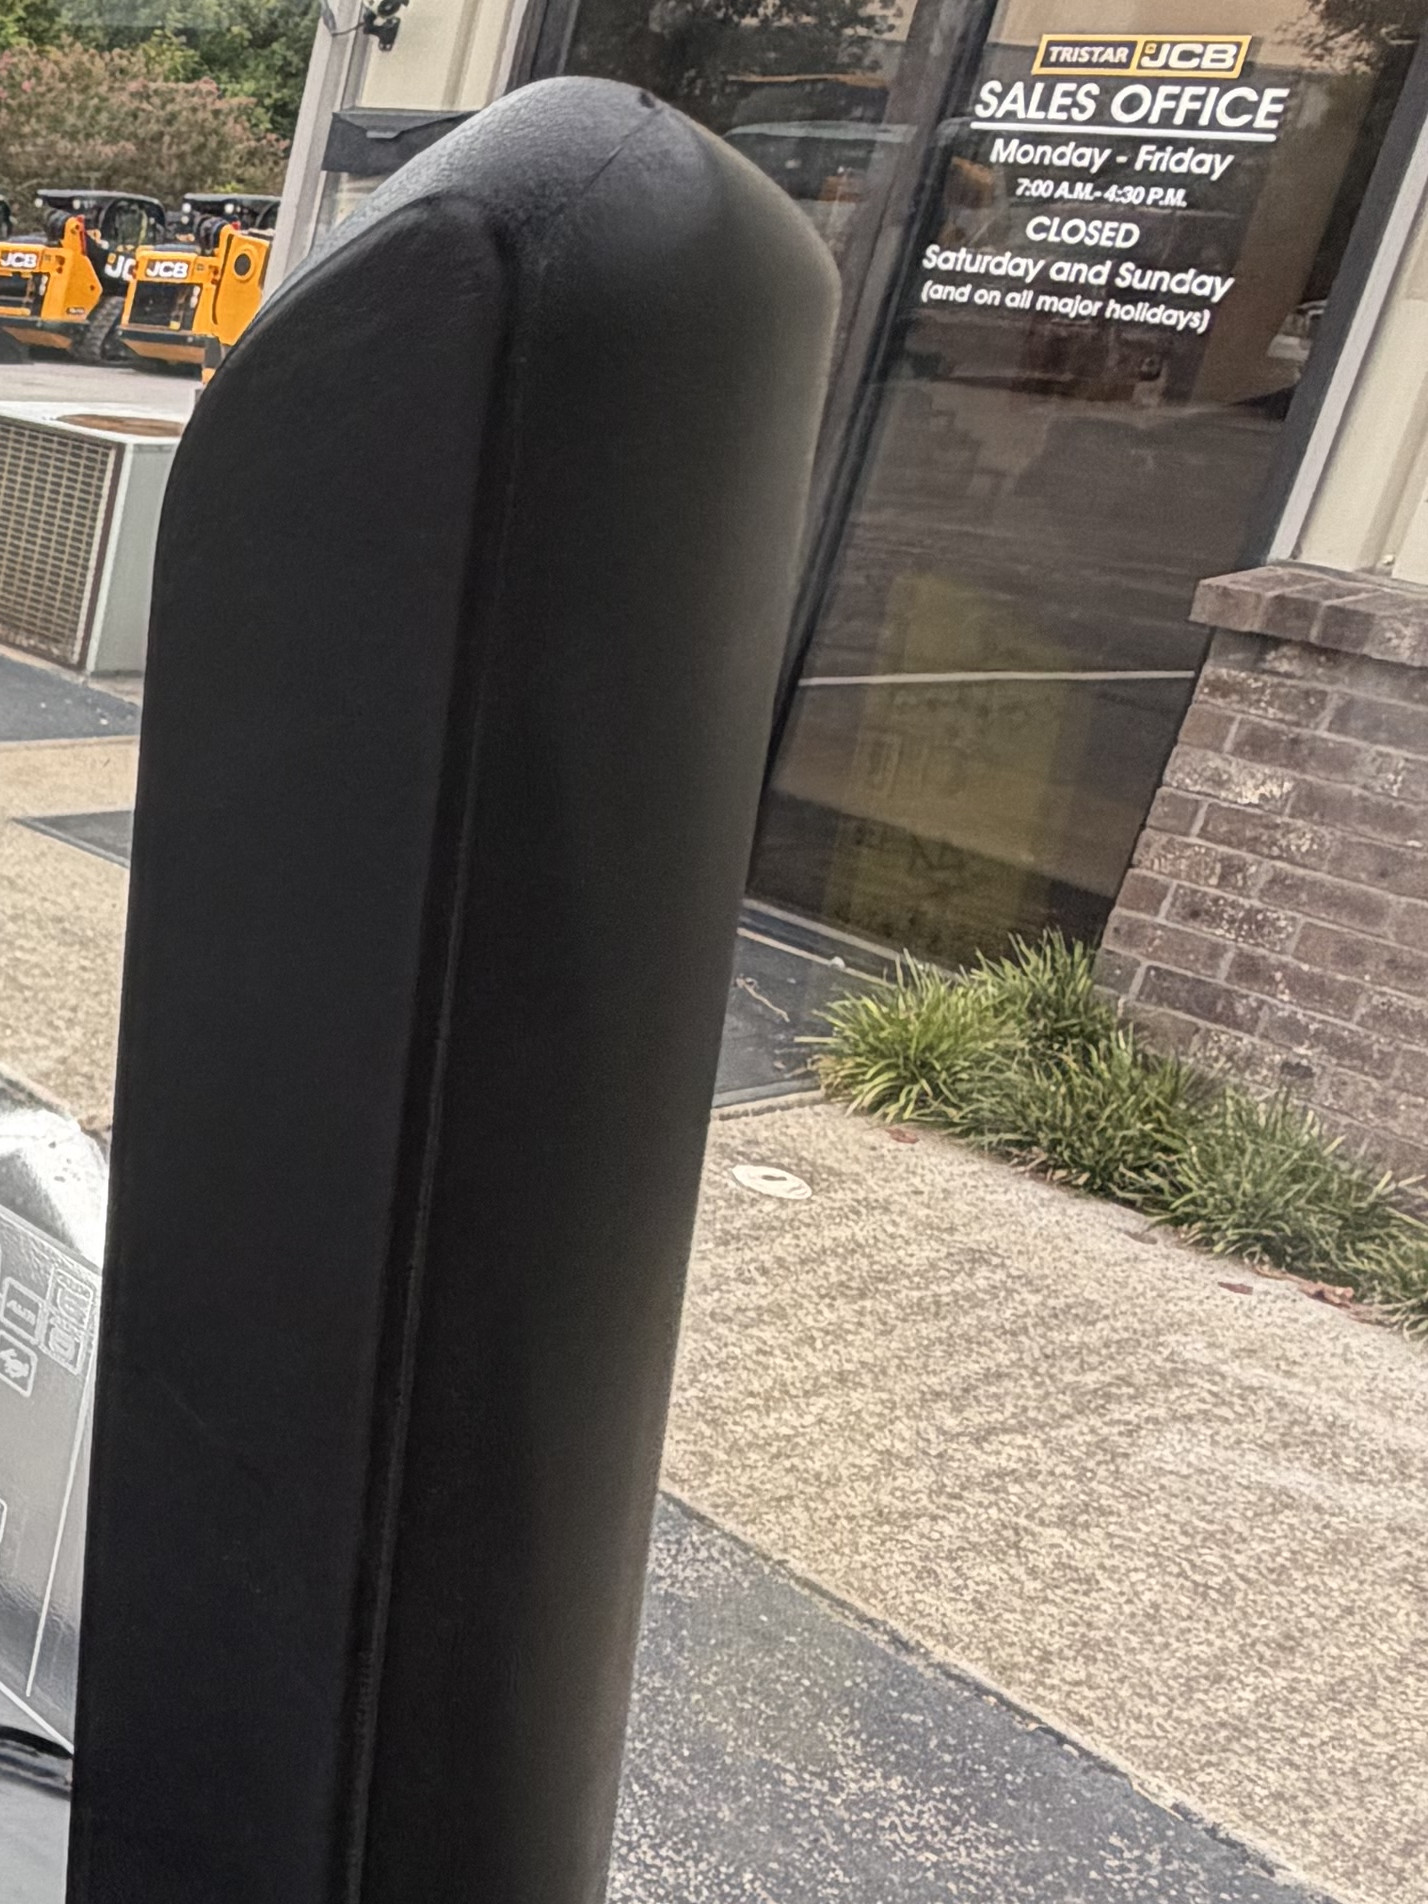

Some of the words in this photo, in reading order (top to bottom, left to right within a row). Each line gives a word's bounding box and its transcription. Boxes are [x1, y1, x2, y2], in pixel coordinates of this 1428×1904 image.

[1048, 46, 1128, 63] TRISTAR
[1140, 43, 1238, 69] JCB
[974, 80, 1101, 122] SALES
[1110, 84, 1290, 129] OFFICE
[990, 138, 1112, 174] Monday
[1134, 145, 1235, 181] Friday
[1016, 177, 1054, 196] 7:00
[1103, 184, 1145, 205] 4:30
[1147, 187, 1187, 208] P.M.
[1025, 216, 1140, 248] CLOSED
[0, 252, 38, 269] JCB
[104, 253, 136, 281] JC
[146, 261, 189, 279] JCB
[922, 244, 1046, 283] Saturday
[1049, 259, 1111, 285] and
[1114, 262, 1236, 303] Sunday
[921, 280, 972, 303] (and
[974, 288, 1002, 306] on
[1005, 289, 1033, 310] all
[1035, 293, 1103, 318] major
[1104, 298, 1210, 334] holidays)
